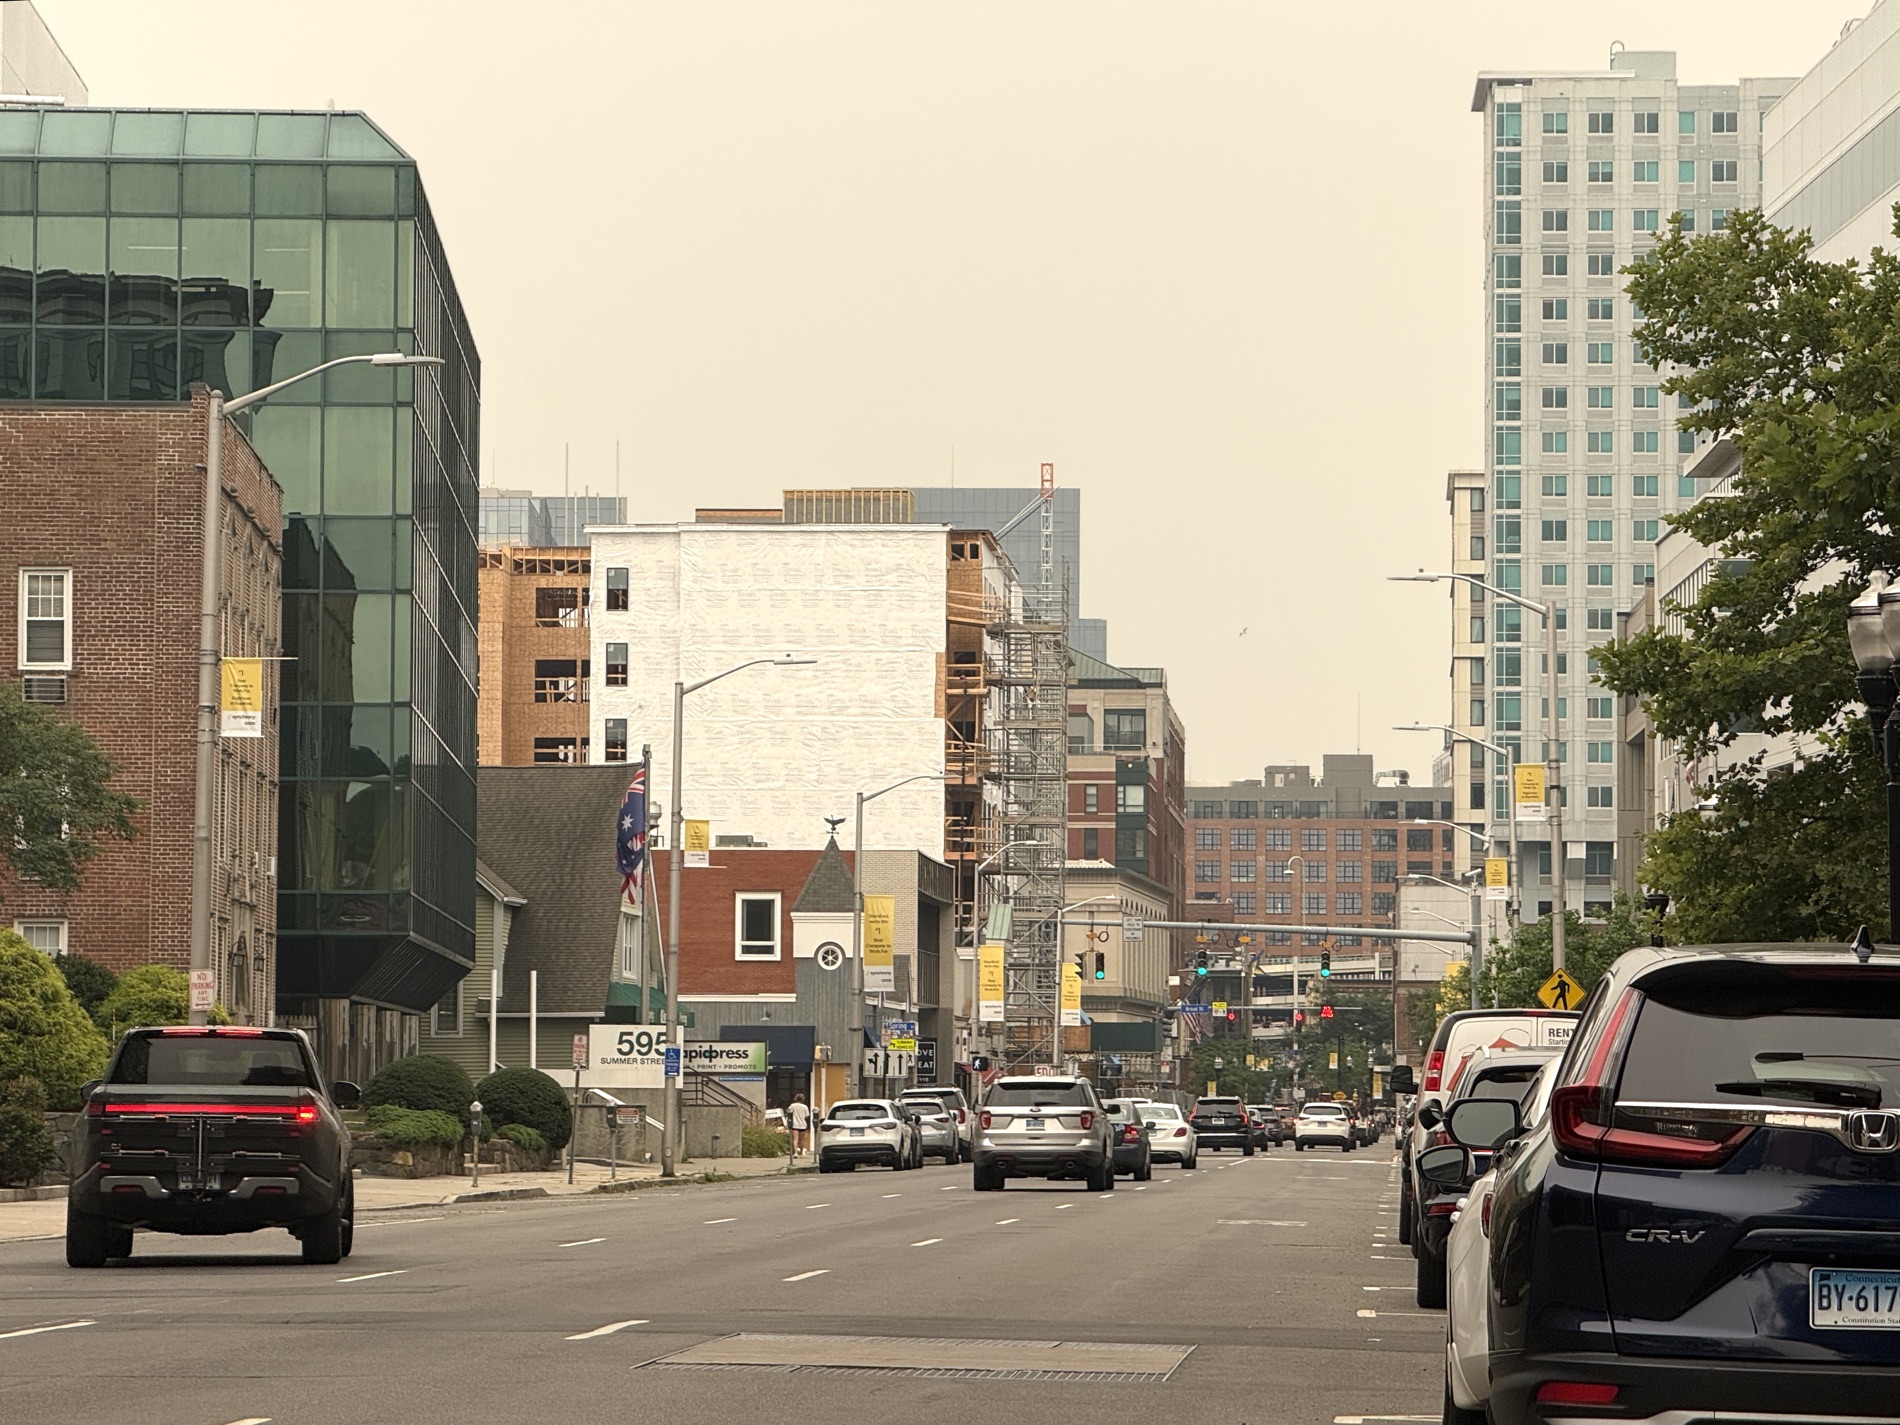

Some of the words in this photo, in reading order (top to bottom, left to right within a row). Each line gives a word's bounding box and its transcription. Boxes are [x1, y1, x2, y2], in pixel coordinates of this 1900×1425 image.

[616, 1031, 666, 1056] 595
[1625, 1229, 1706, 1244] CR-V
[1845, 1274, 1900, 1283] Connecticut
